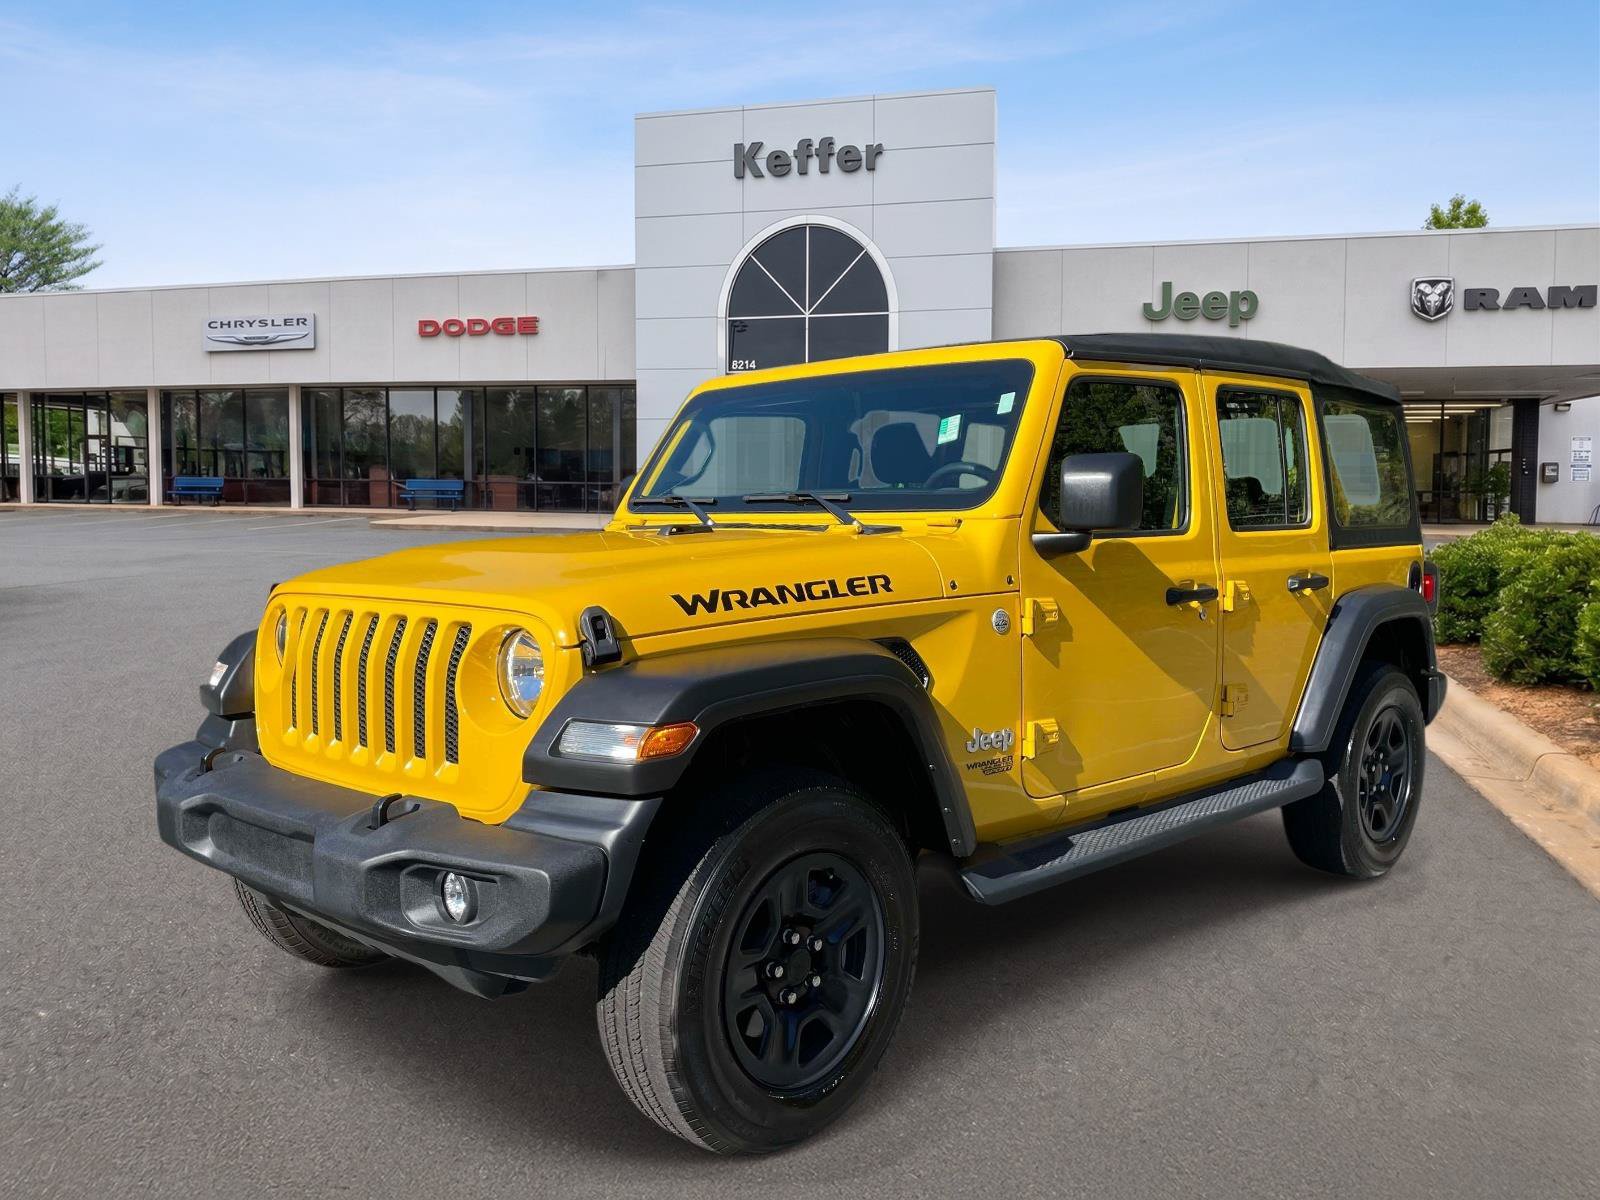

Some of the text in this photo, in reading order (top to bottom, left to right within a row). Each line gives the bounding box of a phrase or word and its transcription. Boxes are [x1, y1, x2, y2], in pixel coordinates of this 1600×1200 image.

[734, 136, 884, 179] Keffer
[1143, 281, 1259, 328] Jeep
[1464, 284, 1598, 311] RAM
[207, 316, 309, 330] CHRYSLER
[418, 315, 540, 338] DODGE
[731, 360, 756, 370] 8214
[670, 573, 895, 617] WRANGLER
[966, 727, 1015, 753] Jeep
[965, 755, 1014, 770] WRANGLER
